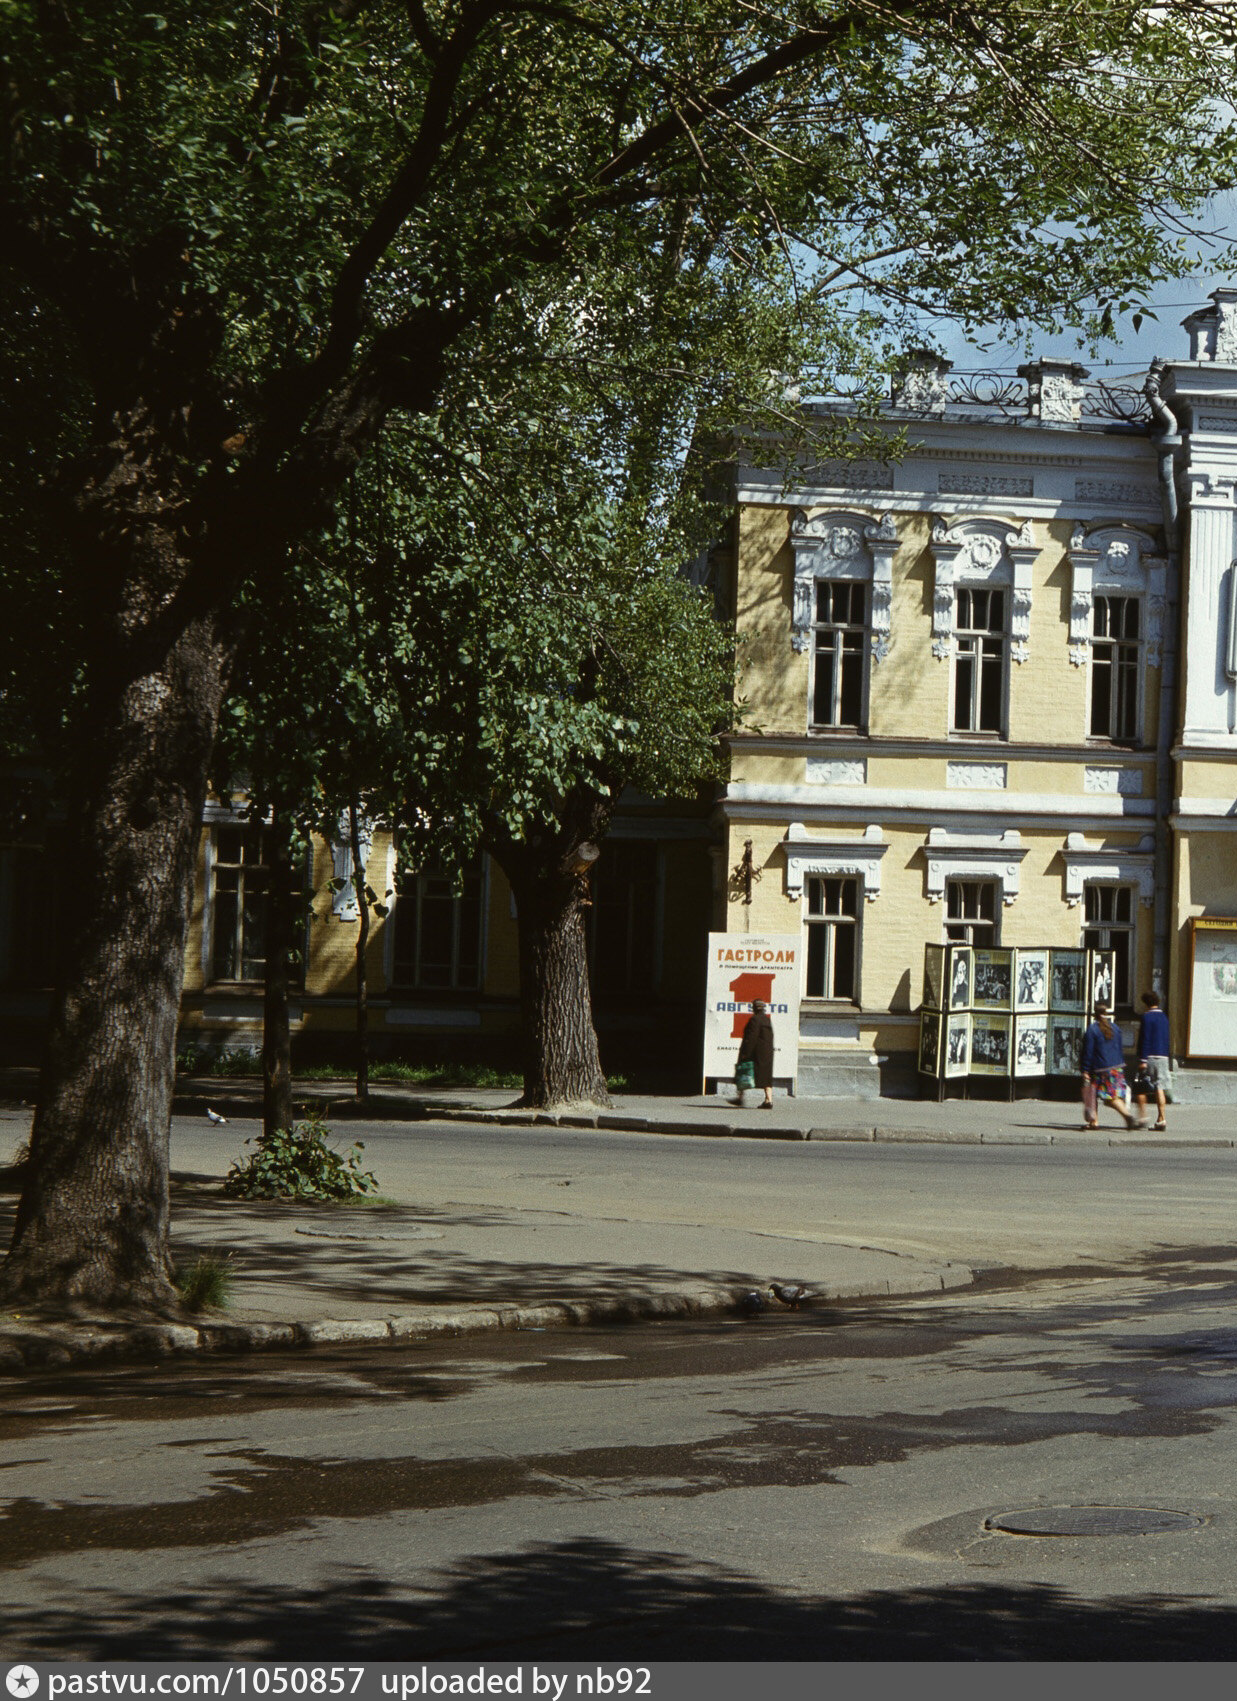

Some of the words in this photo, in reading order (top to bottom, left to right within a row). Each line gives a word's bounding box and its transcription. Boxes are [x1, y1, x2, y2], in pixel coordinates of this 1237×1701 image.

[717, 949, 795, 963] ГАСТРОЛИ
[716, 1001, 788, 1014] АВГУТА
[729, 973, 775, 1038] 1
